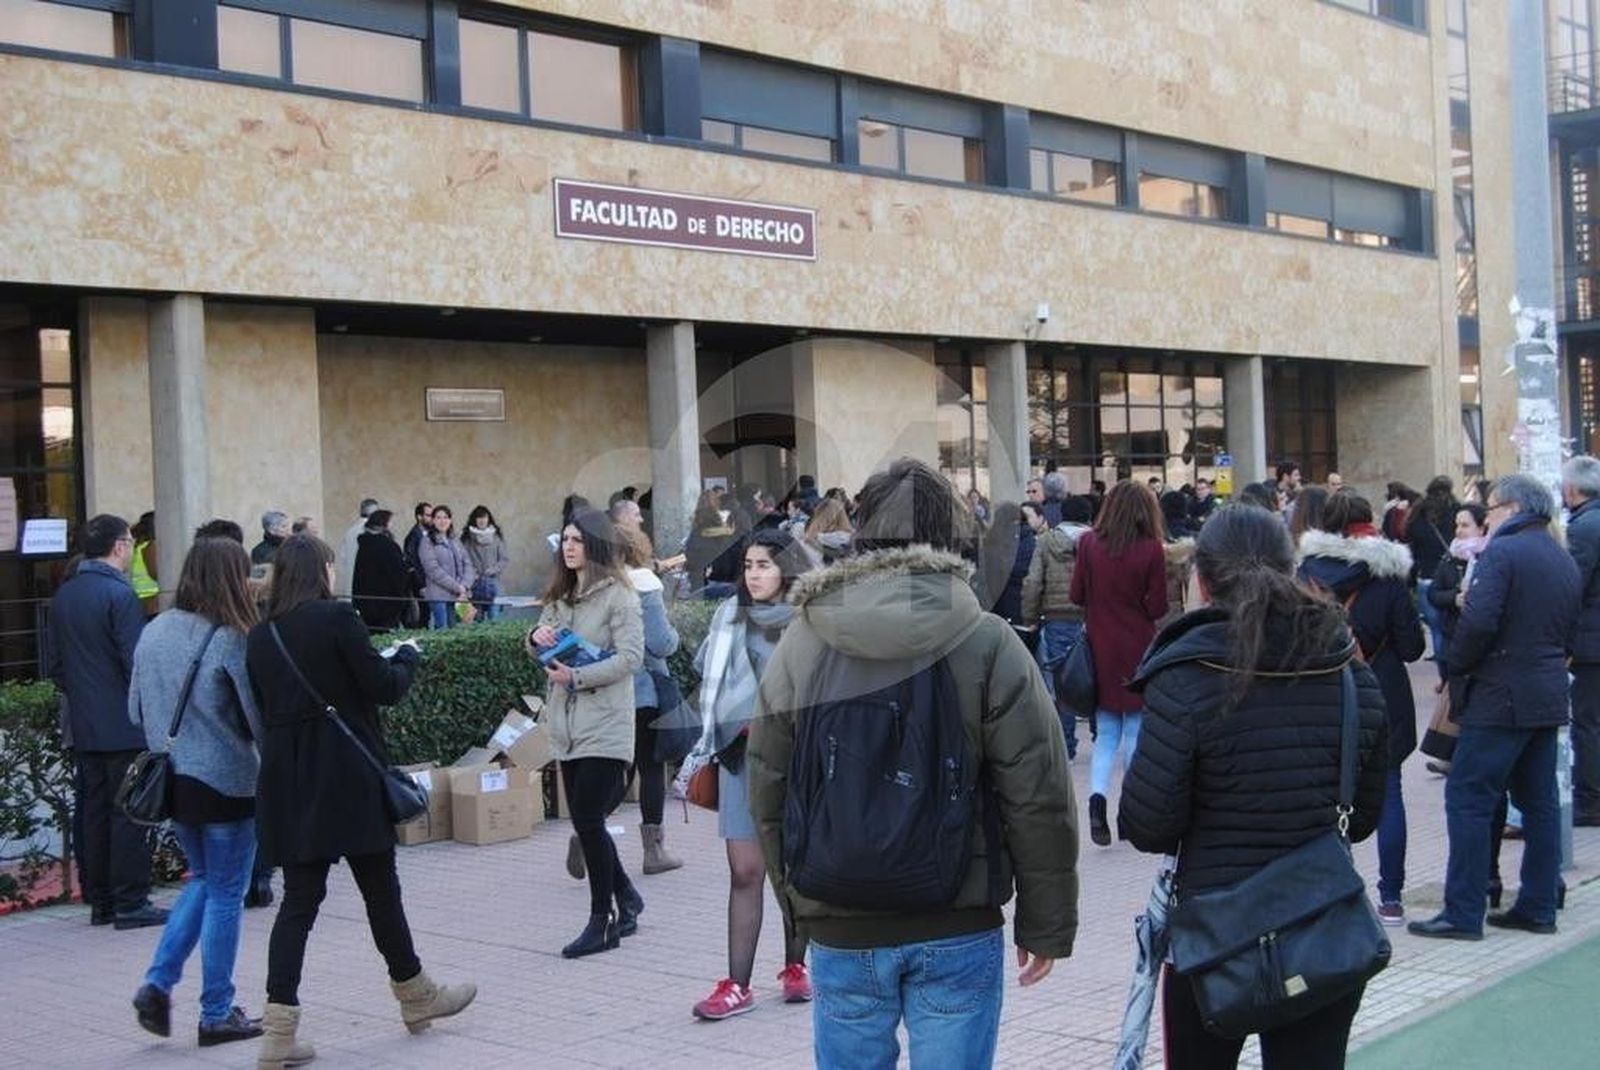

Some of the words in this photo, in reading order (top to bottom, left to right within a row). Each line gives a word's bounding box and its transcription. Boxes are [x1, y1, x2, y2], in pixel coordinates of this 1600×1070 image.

[569, 198, 678, 231] FACULTAD
[687, 217, 707, 235] DE
[715, 214, 805, 245] DERECHO
